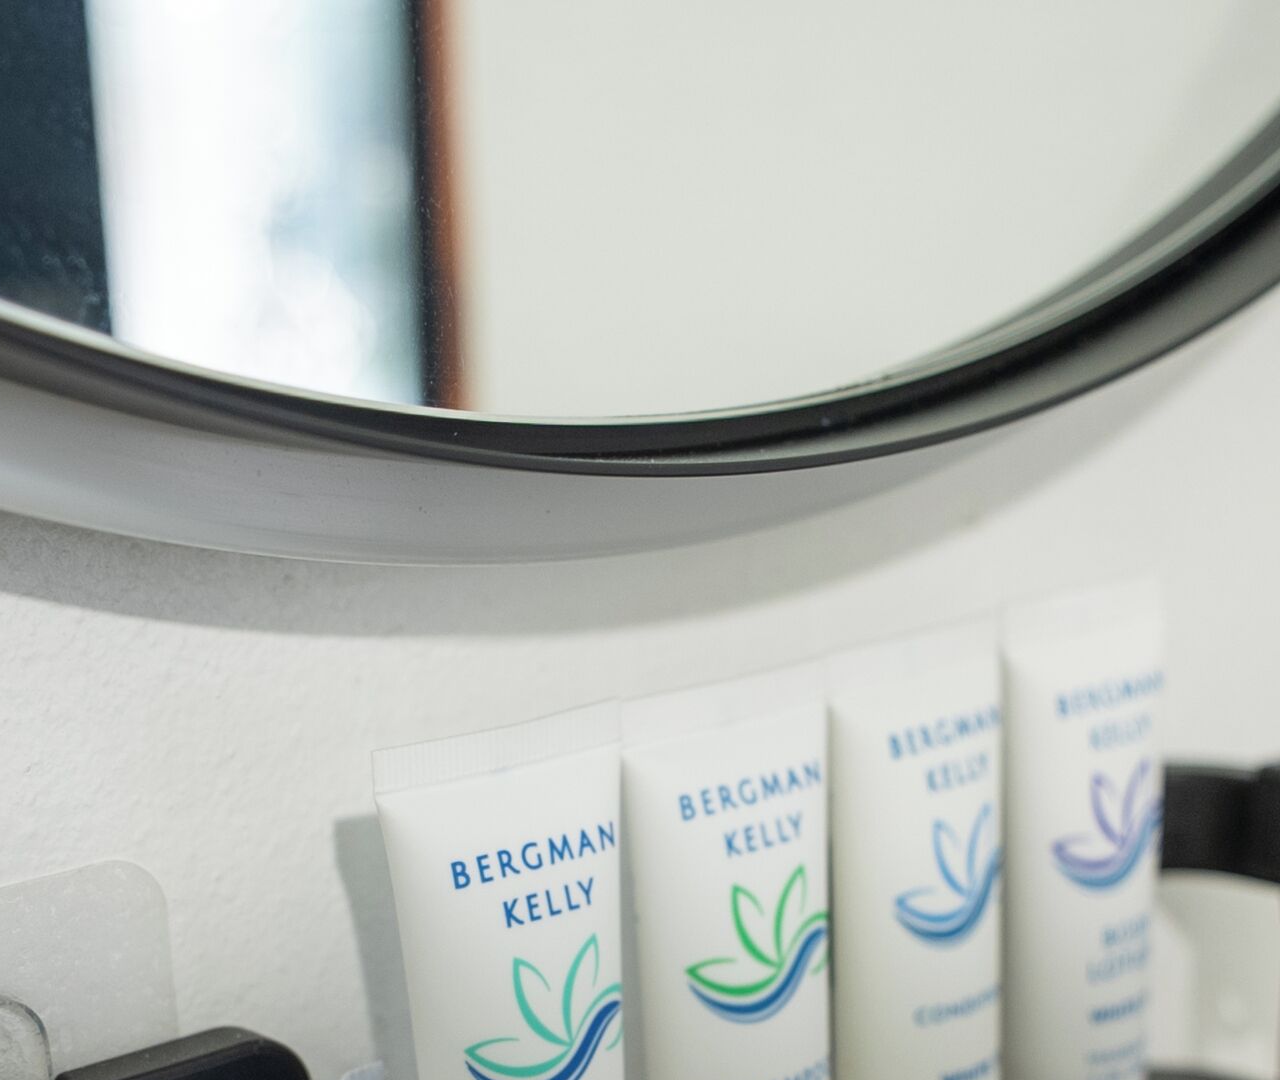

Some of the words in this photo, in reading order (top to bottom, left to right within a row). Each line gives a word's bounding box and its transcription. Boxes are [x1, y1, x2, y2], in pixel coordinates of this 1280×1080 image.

[677, 759, 823, 822] BERGMAN
[449, 820, 617, 891] BERGMAN
[722, 811, 804, 859] KELLY
[502, 877, 595, 929] KELLY
